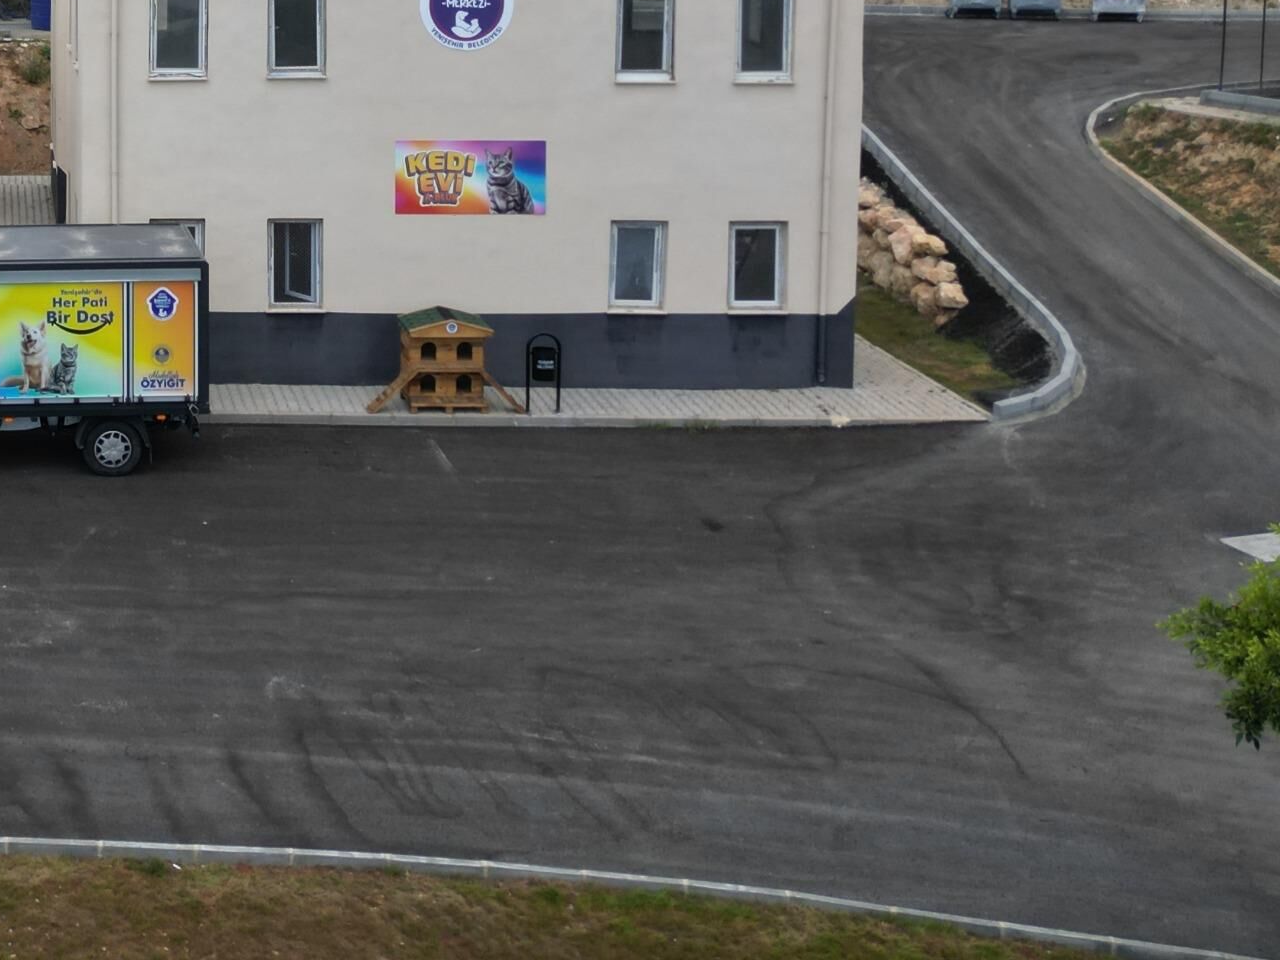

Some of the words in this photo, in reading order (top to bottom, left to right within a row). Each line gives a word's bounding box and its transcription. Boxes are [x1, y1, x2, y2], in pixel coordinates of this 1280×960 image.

[405, 151, 476, 177] KEDİ
[418, 173, 463, 194] EVİ
[52, 297, 77, 308] Her
[82, 296, 108, 307] Pati
[47, 310, 71, 324] Bir
[77, 310, 114, 324] Dost
